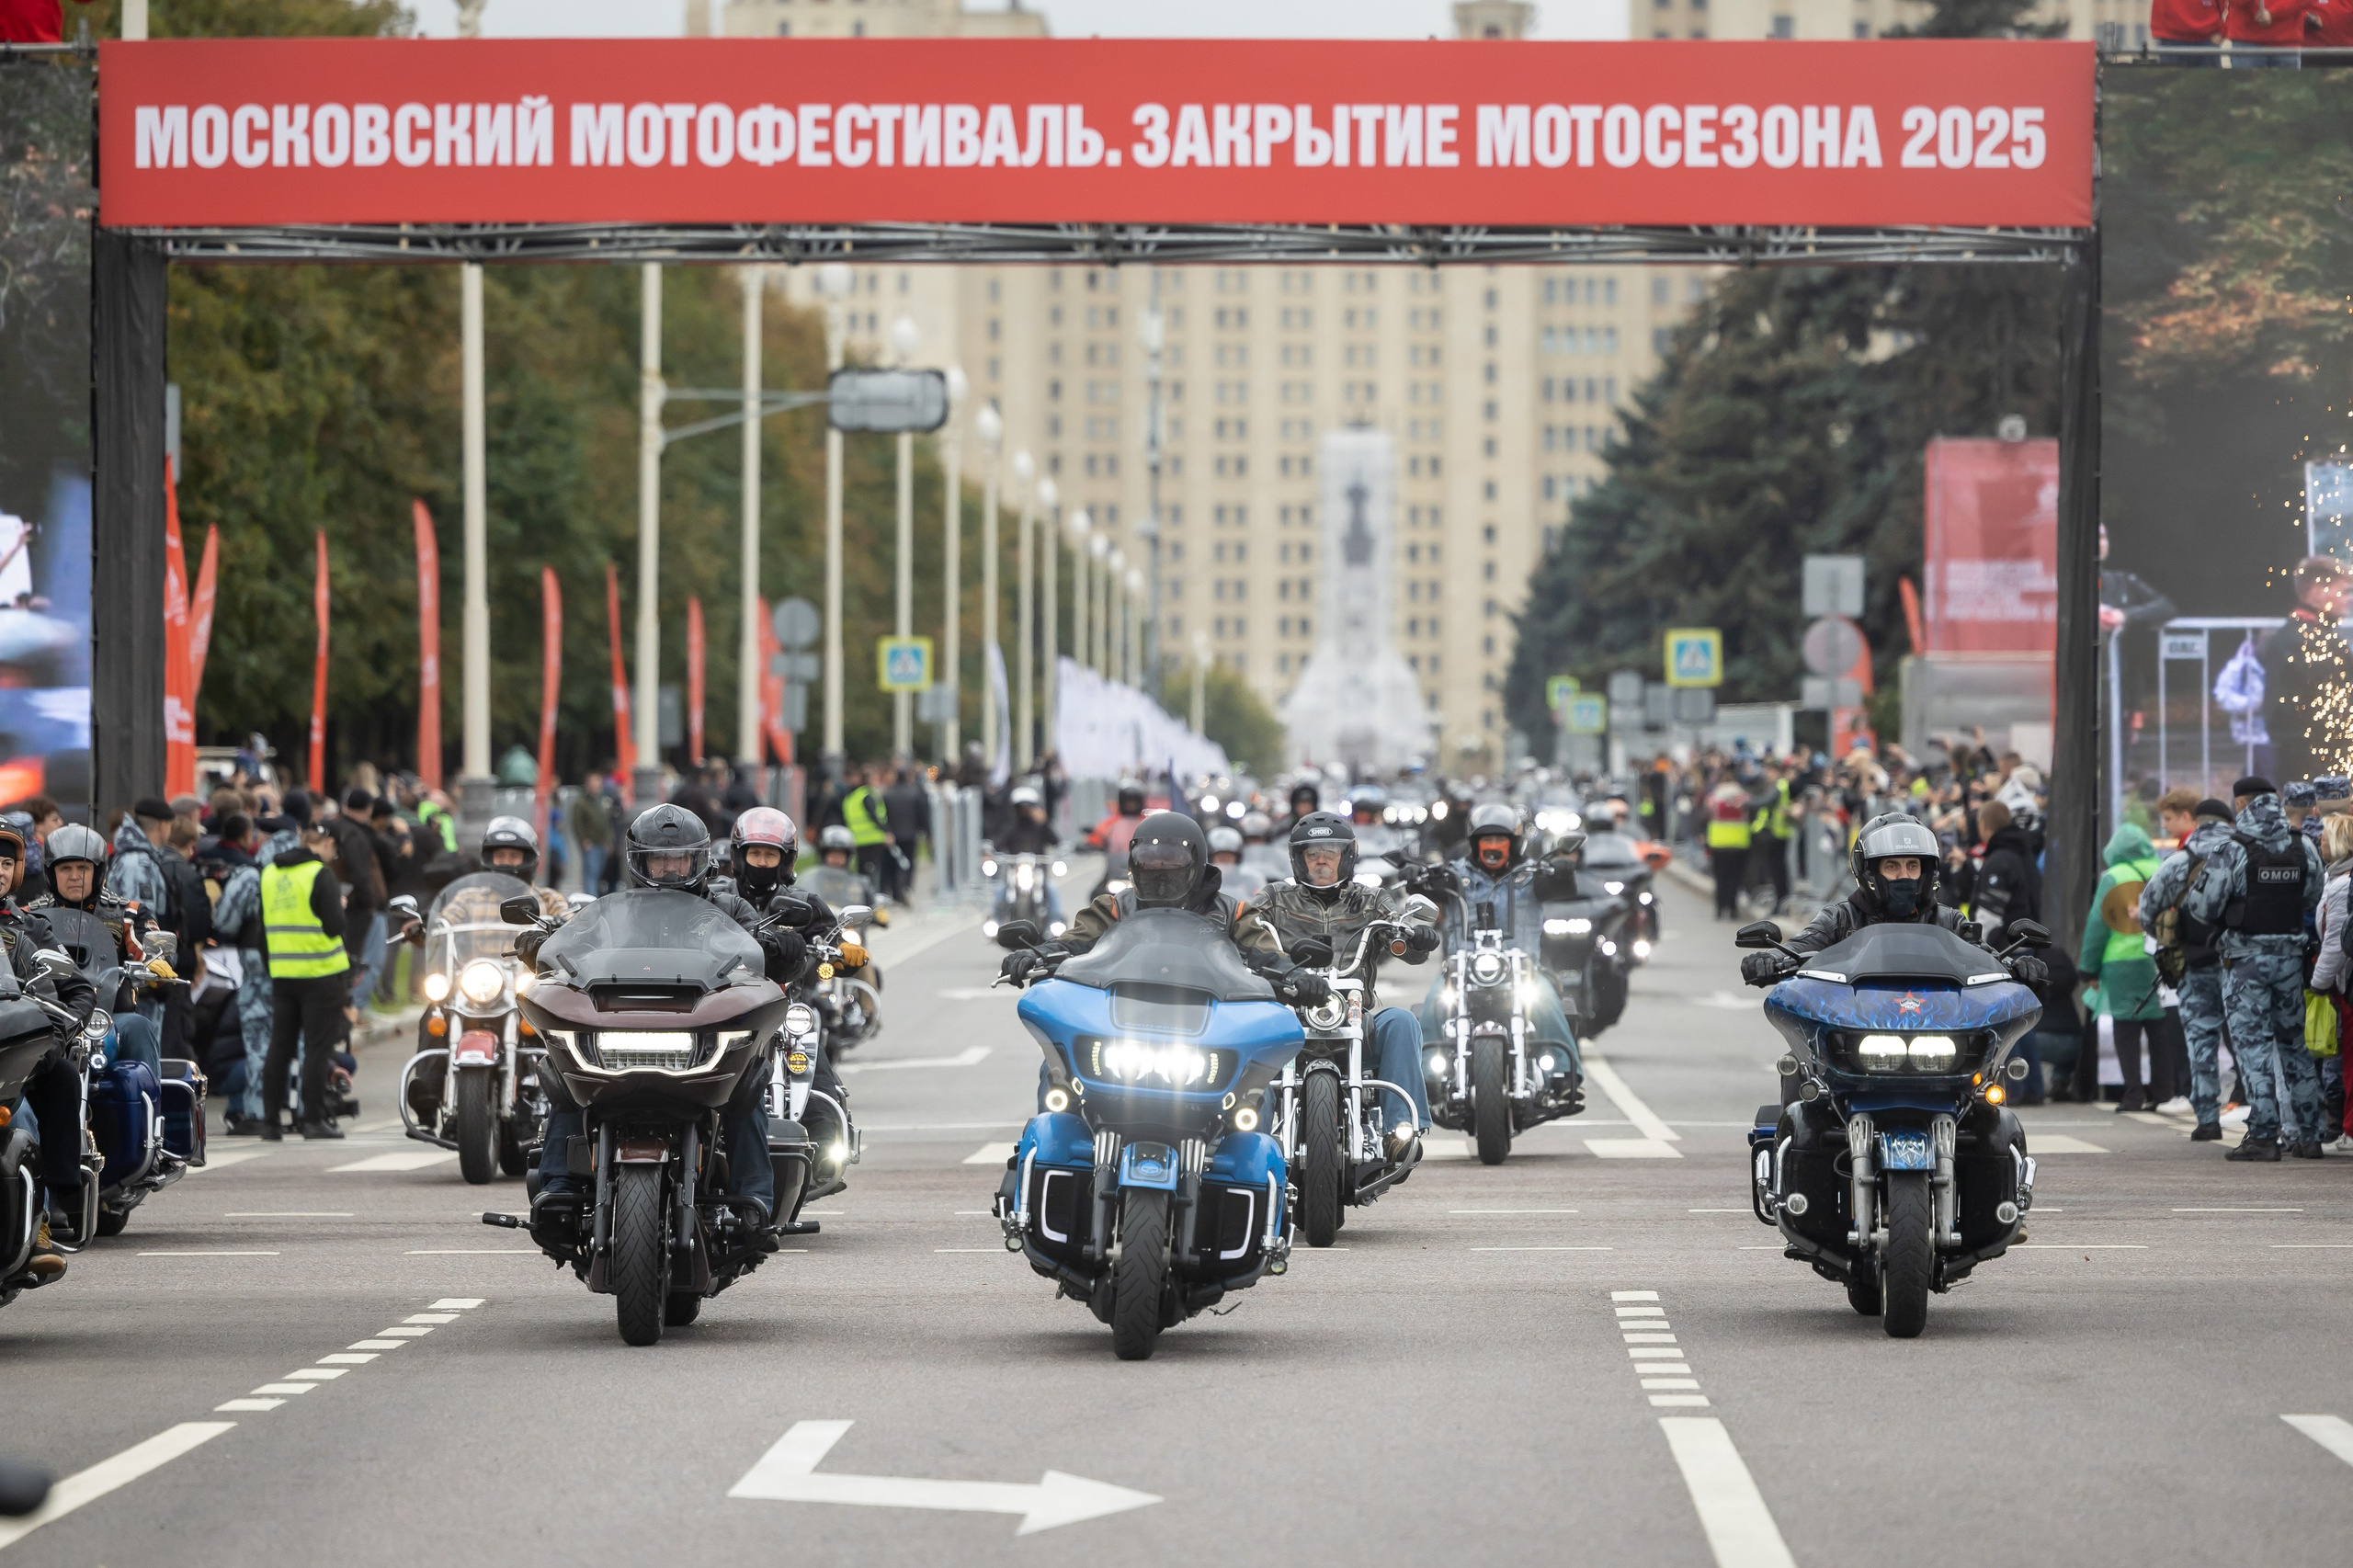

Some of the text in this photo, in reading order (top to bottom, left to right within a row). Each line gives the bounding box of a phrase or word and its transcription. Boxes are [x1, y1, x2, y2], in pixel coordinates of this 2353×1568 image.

[135, 95, 2047, 170] МОСКОВСКИЙ МОТОФЕСТИВАЛЬ. ЗАКРЫТИЕ МОТОСЕЗОНА 2025
[2260, 869, 2299, 881] ОМОН
